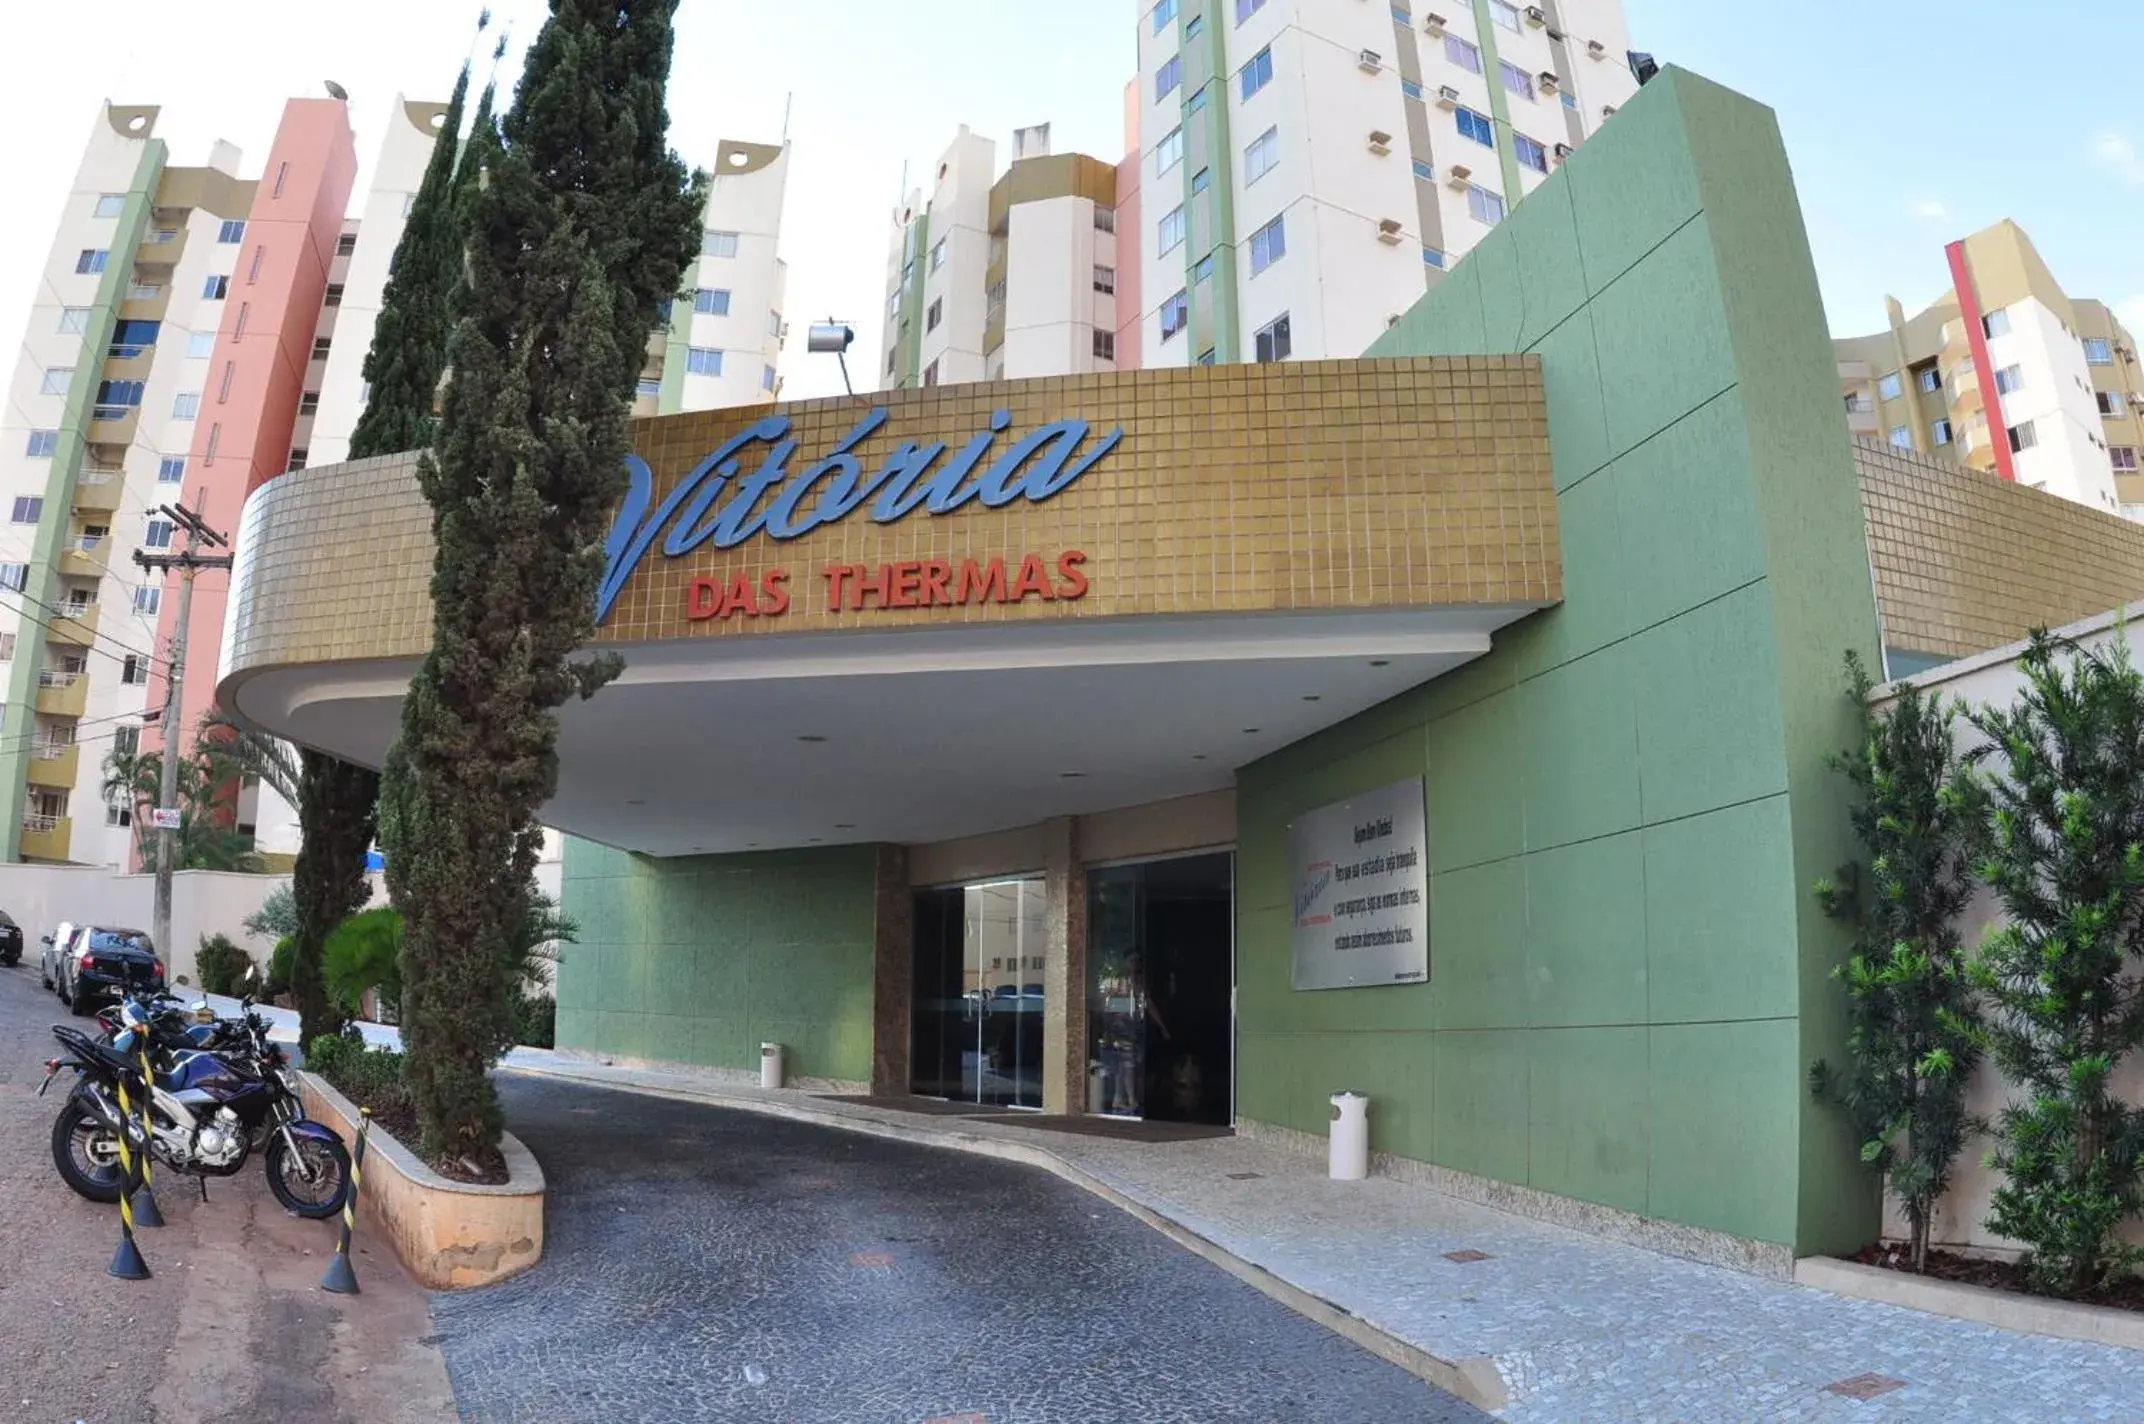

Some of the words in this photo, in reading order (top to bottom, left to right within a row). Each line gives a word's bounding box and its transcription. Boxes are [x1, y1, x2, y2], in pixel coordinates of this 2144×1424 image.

[594, 406, 1123, 626] Vitória
[687, 567, 791, 621] DAS
[823, 549, 1090, 612] THERMAS
